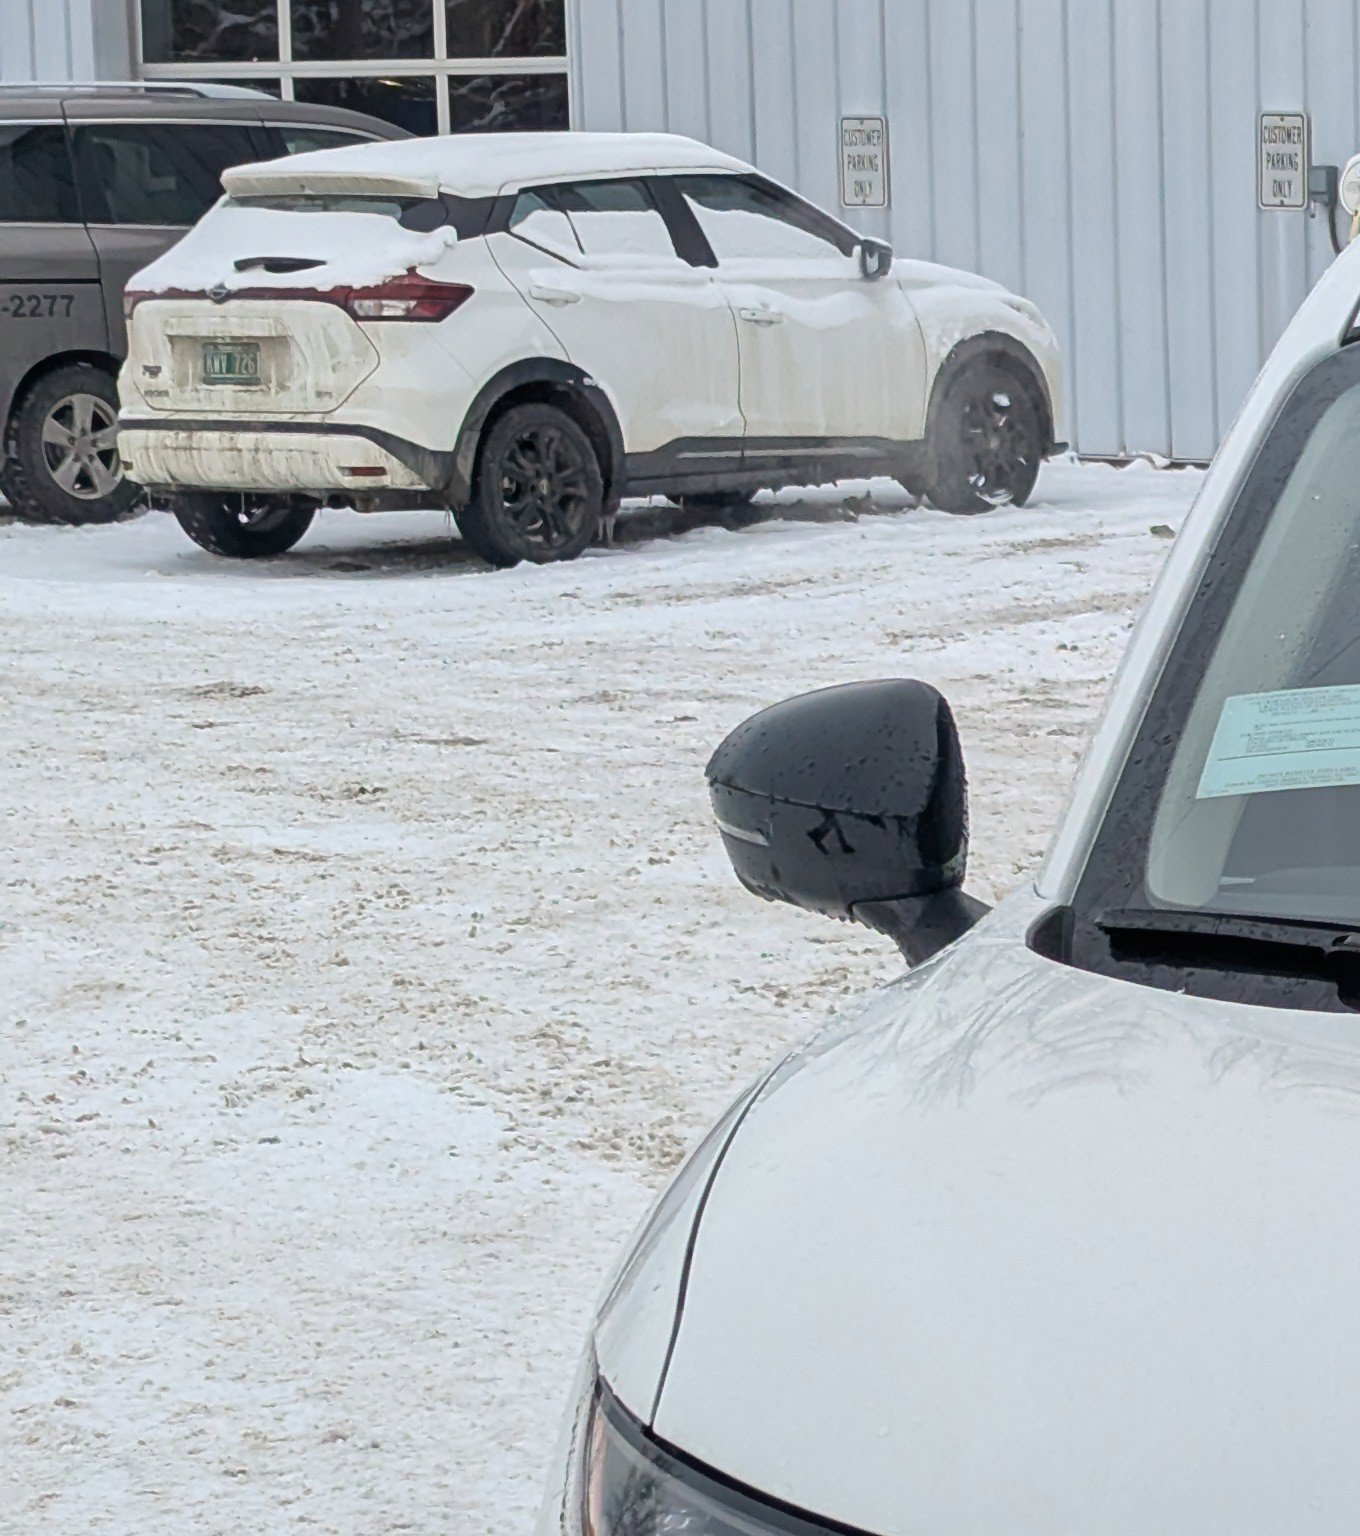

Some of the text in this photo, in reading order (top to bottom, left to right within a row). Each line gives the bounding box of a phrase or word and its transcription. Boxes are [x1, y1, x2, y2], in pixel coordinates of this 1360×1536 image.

[844, 129, 881, 146] CUSTOMER
[1263, 125, 1302, 144] CUSTOMER
[847, 154, 880, 172] PARKING
[1266, 152, 1299, 172] PARKING
[854, 180, 874, 198] ONLY
[1272, 179, 1293, 198] ONLY
